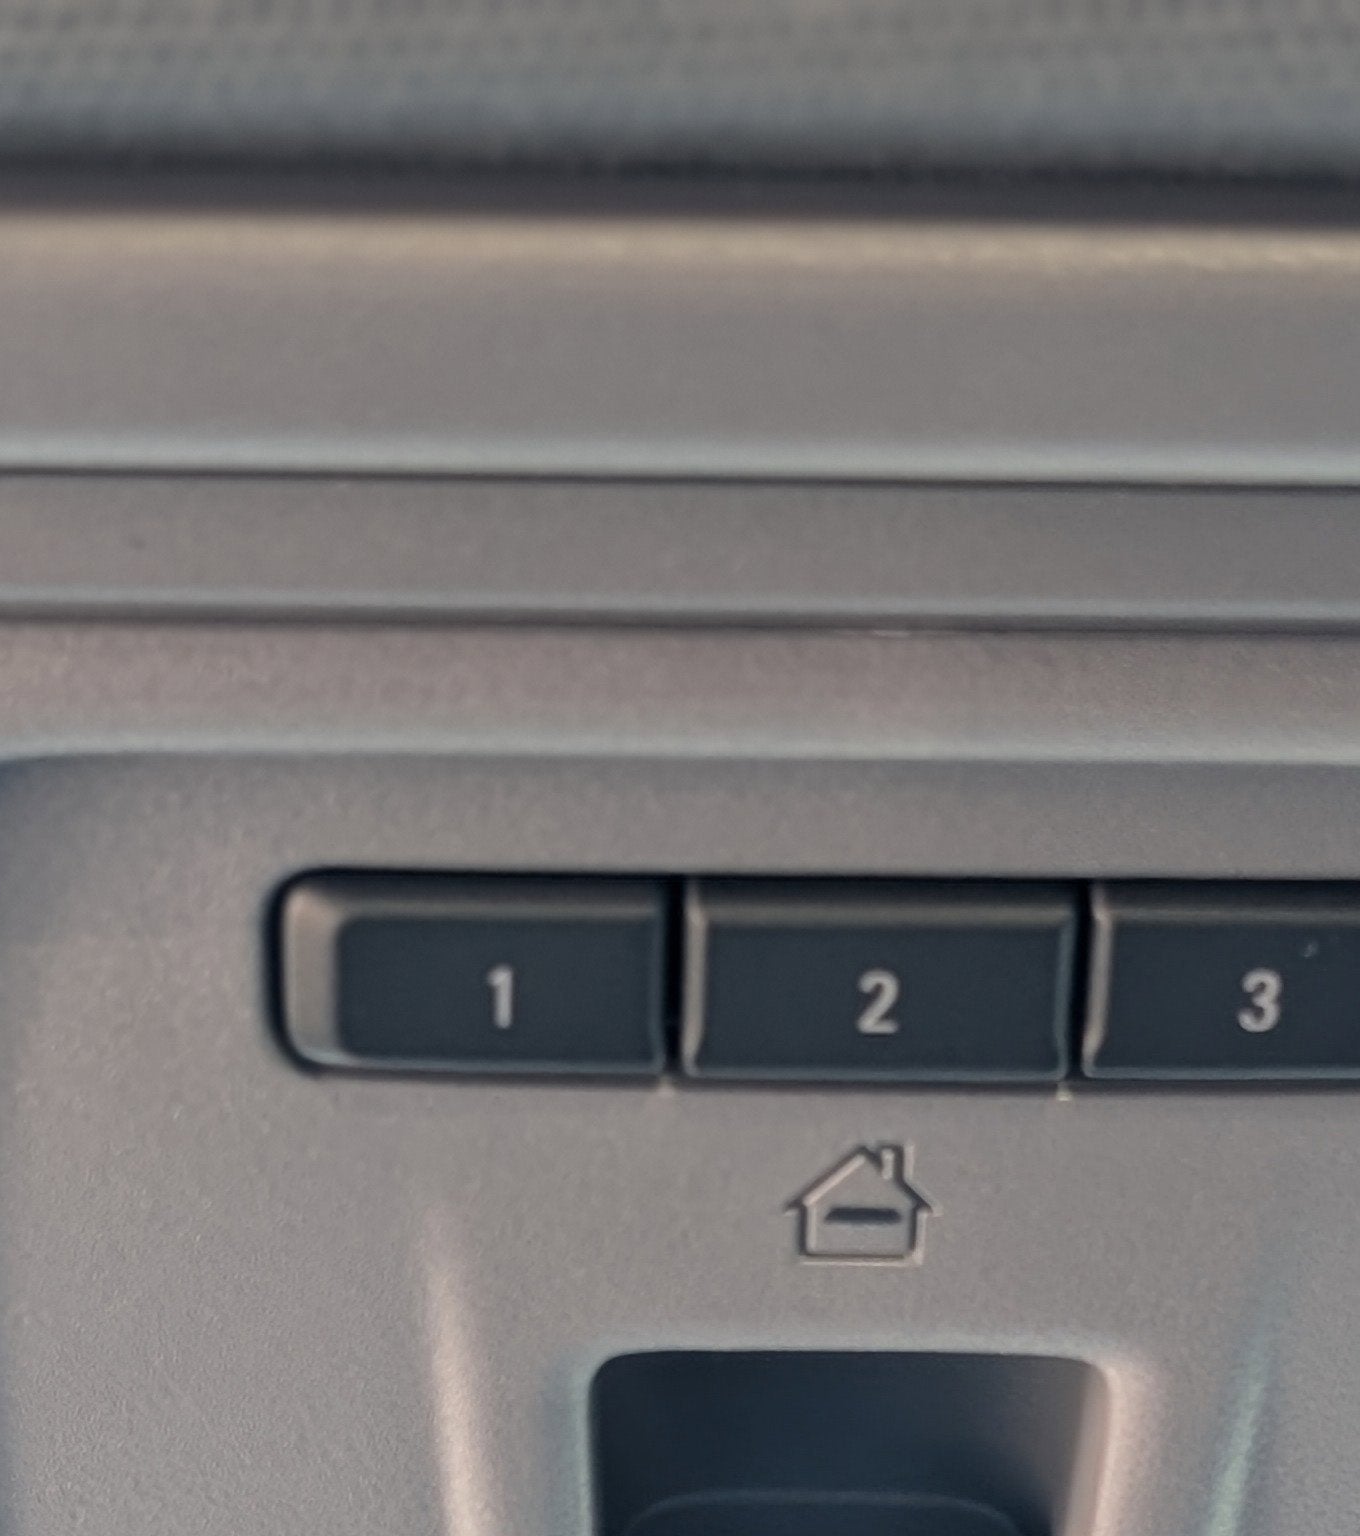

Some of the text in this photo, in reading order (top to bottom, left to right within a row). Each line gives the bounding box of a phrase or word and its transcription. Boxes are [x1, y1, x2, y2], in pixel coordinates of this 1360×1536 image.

[488, 966, 513, 1028] 1
[858, 971, 899, 1033] 2
[1240, 969, 1282, 1031] 3
